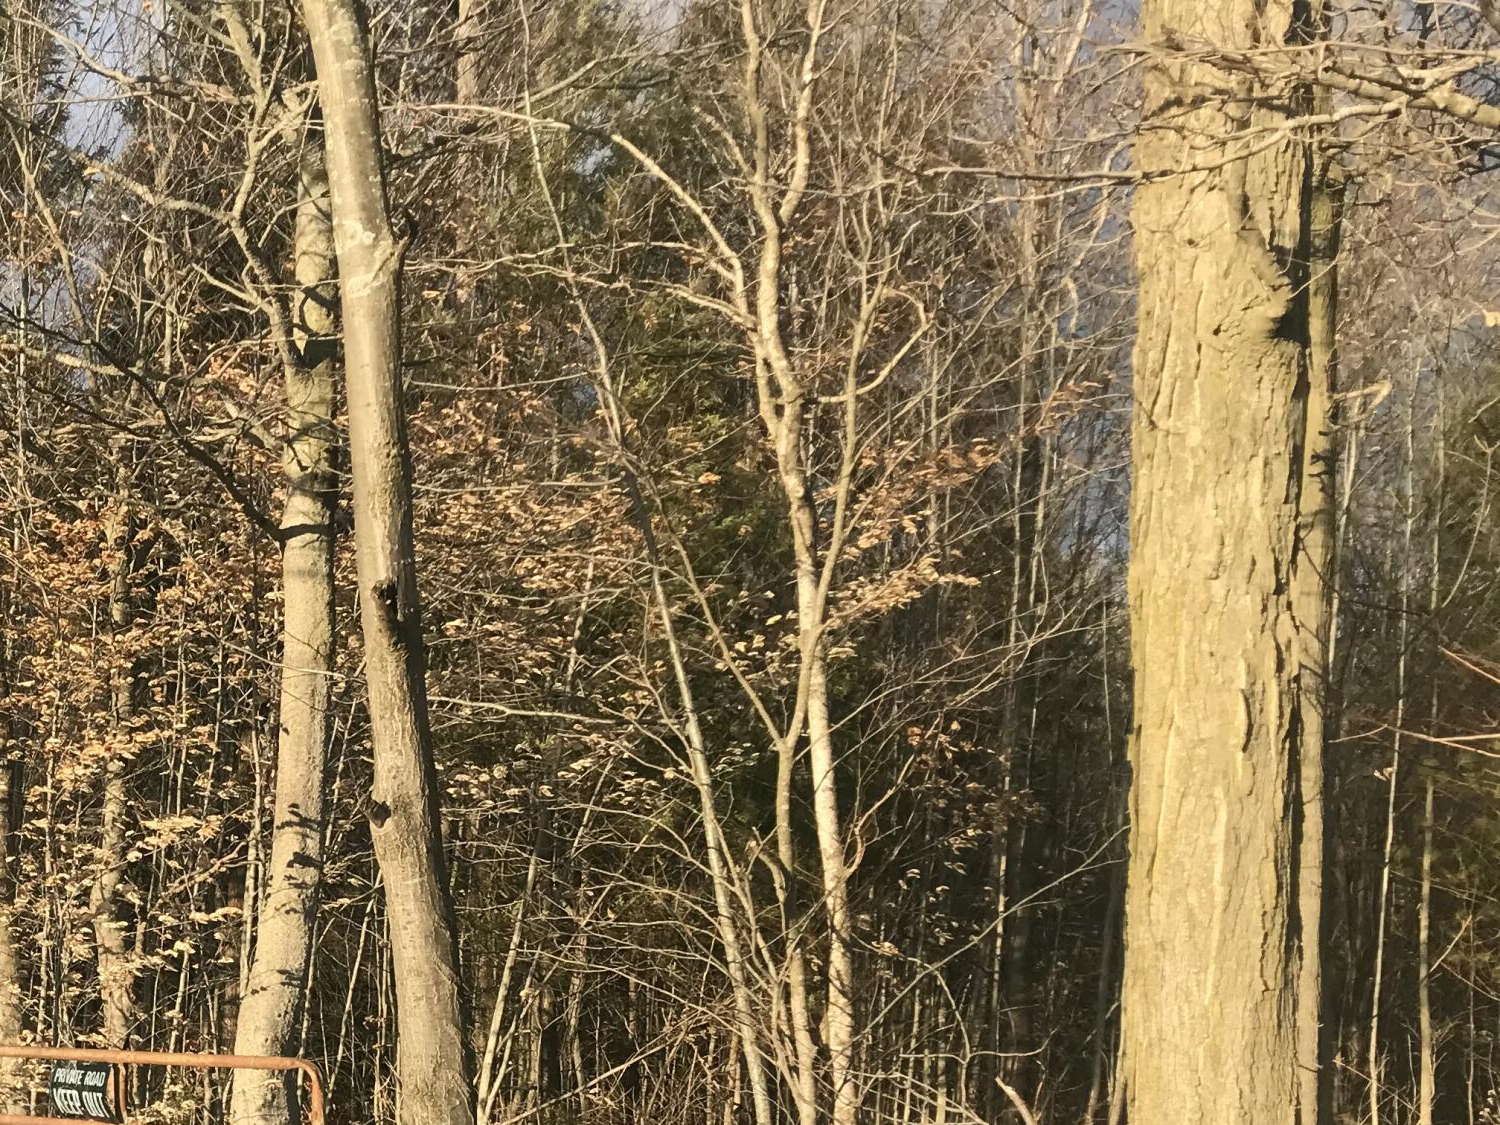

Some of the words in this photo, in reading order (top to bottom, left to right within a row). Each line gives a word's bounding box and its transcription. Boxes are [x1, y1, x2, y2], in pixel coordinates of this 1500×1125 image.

[53, 1067, 85, 1085] PRIVATE
[84, 1071, 107, 1087] ROAD
[52, 1088, 83, 1116] KEEP
[82, 1091, 110, 1118] OUT
